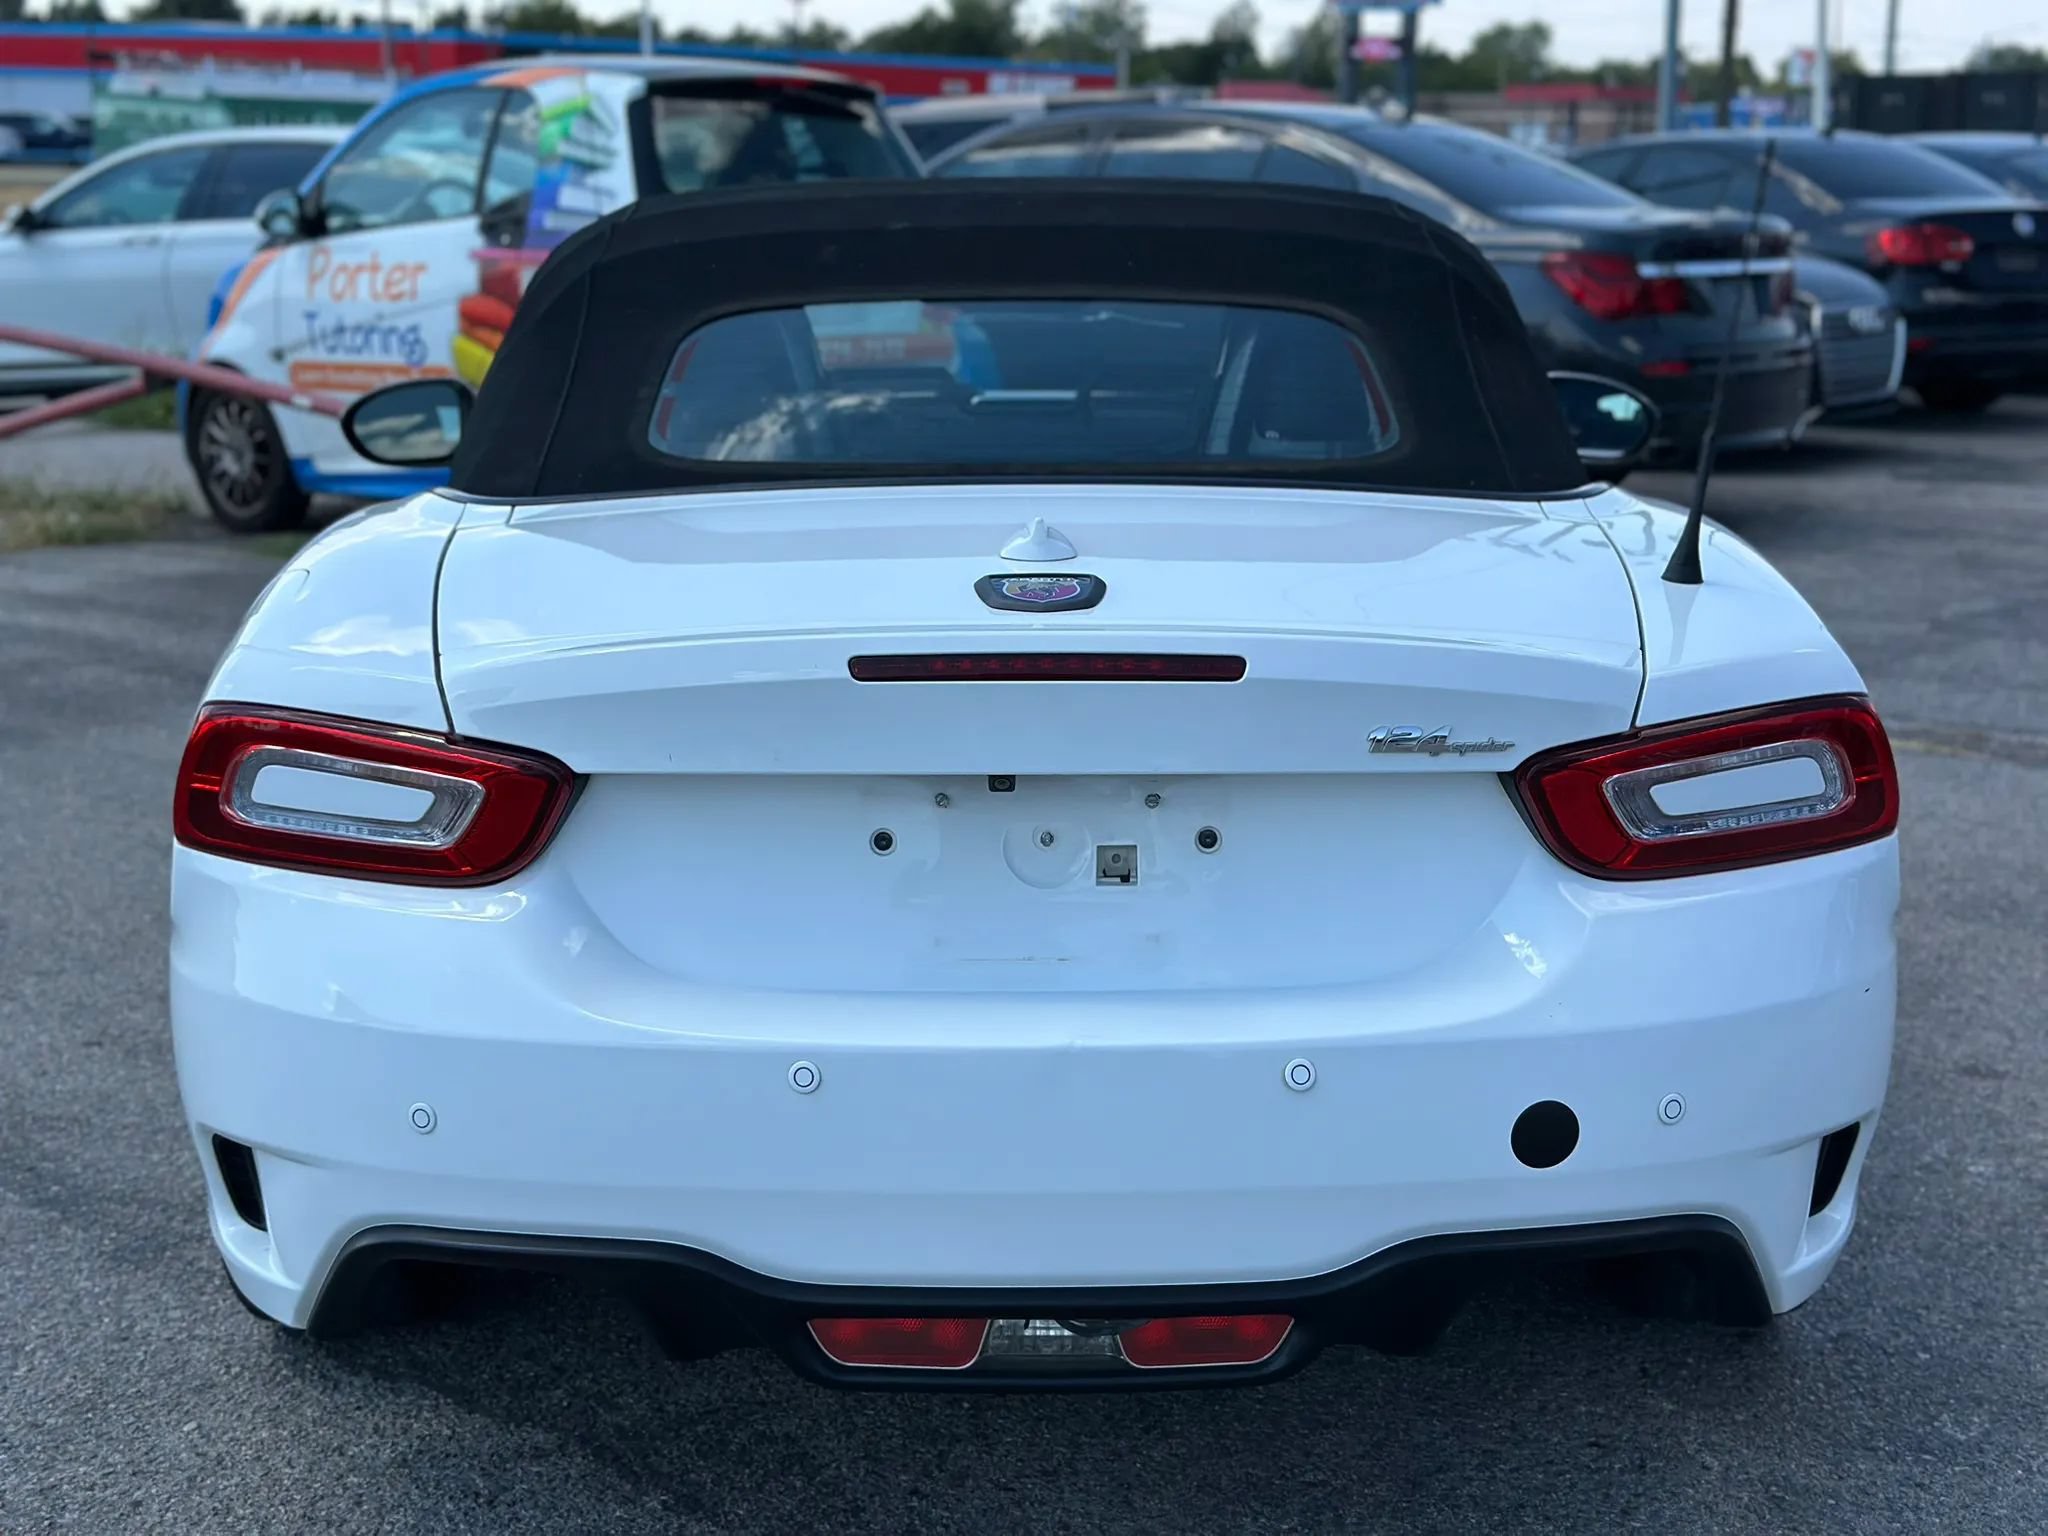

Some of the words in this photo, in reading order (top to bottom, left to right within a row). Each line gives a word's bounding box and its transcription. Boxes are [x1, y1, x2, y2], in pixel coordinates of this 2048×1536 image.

[307, 244, 428, 303] Porter
[304, 310, 428, 368] Tutoring
[1368, 724, 1451, 756] 124
[1451, 737, 1515, 757] spider
